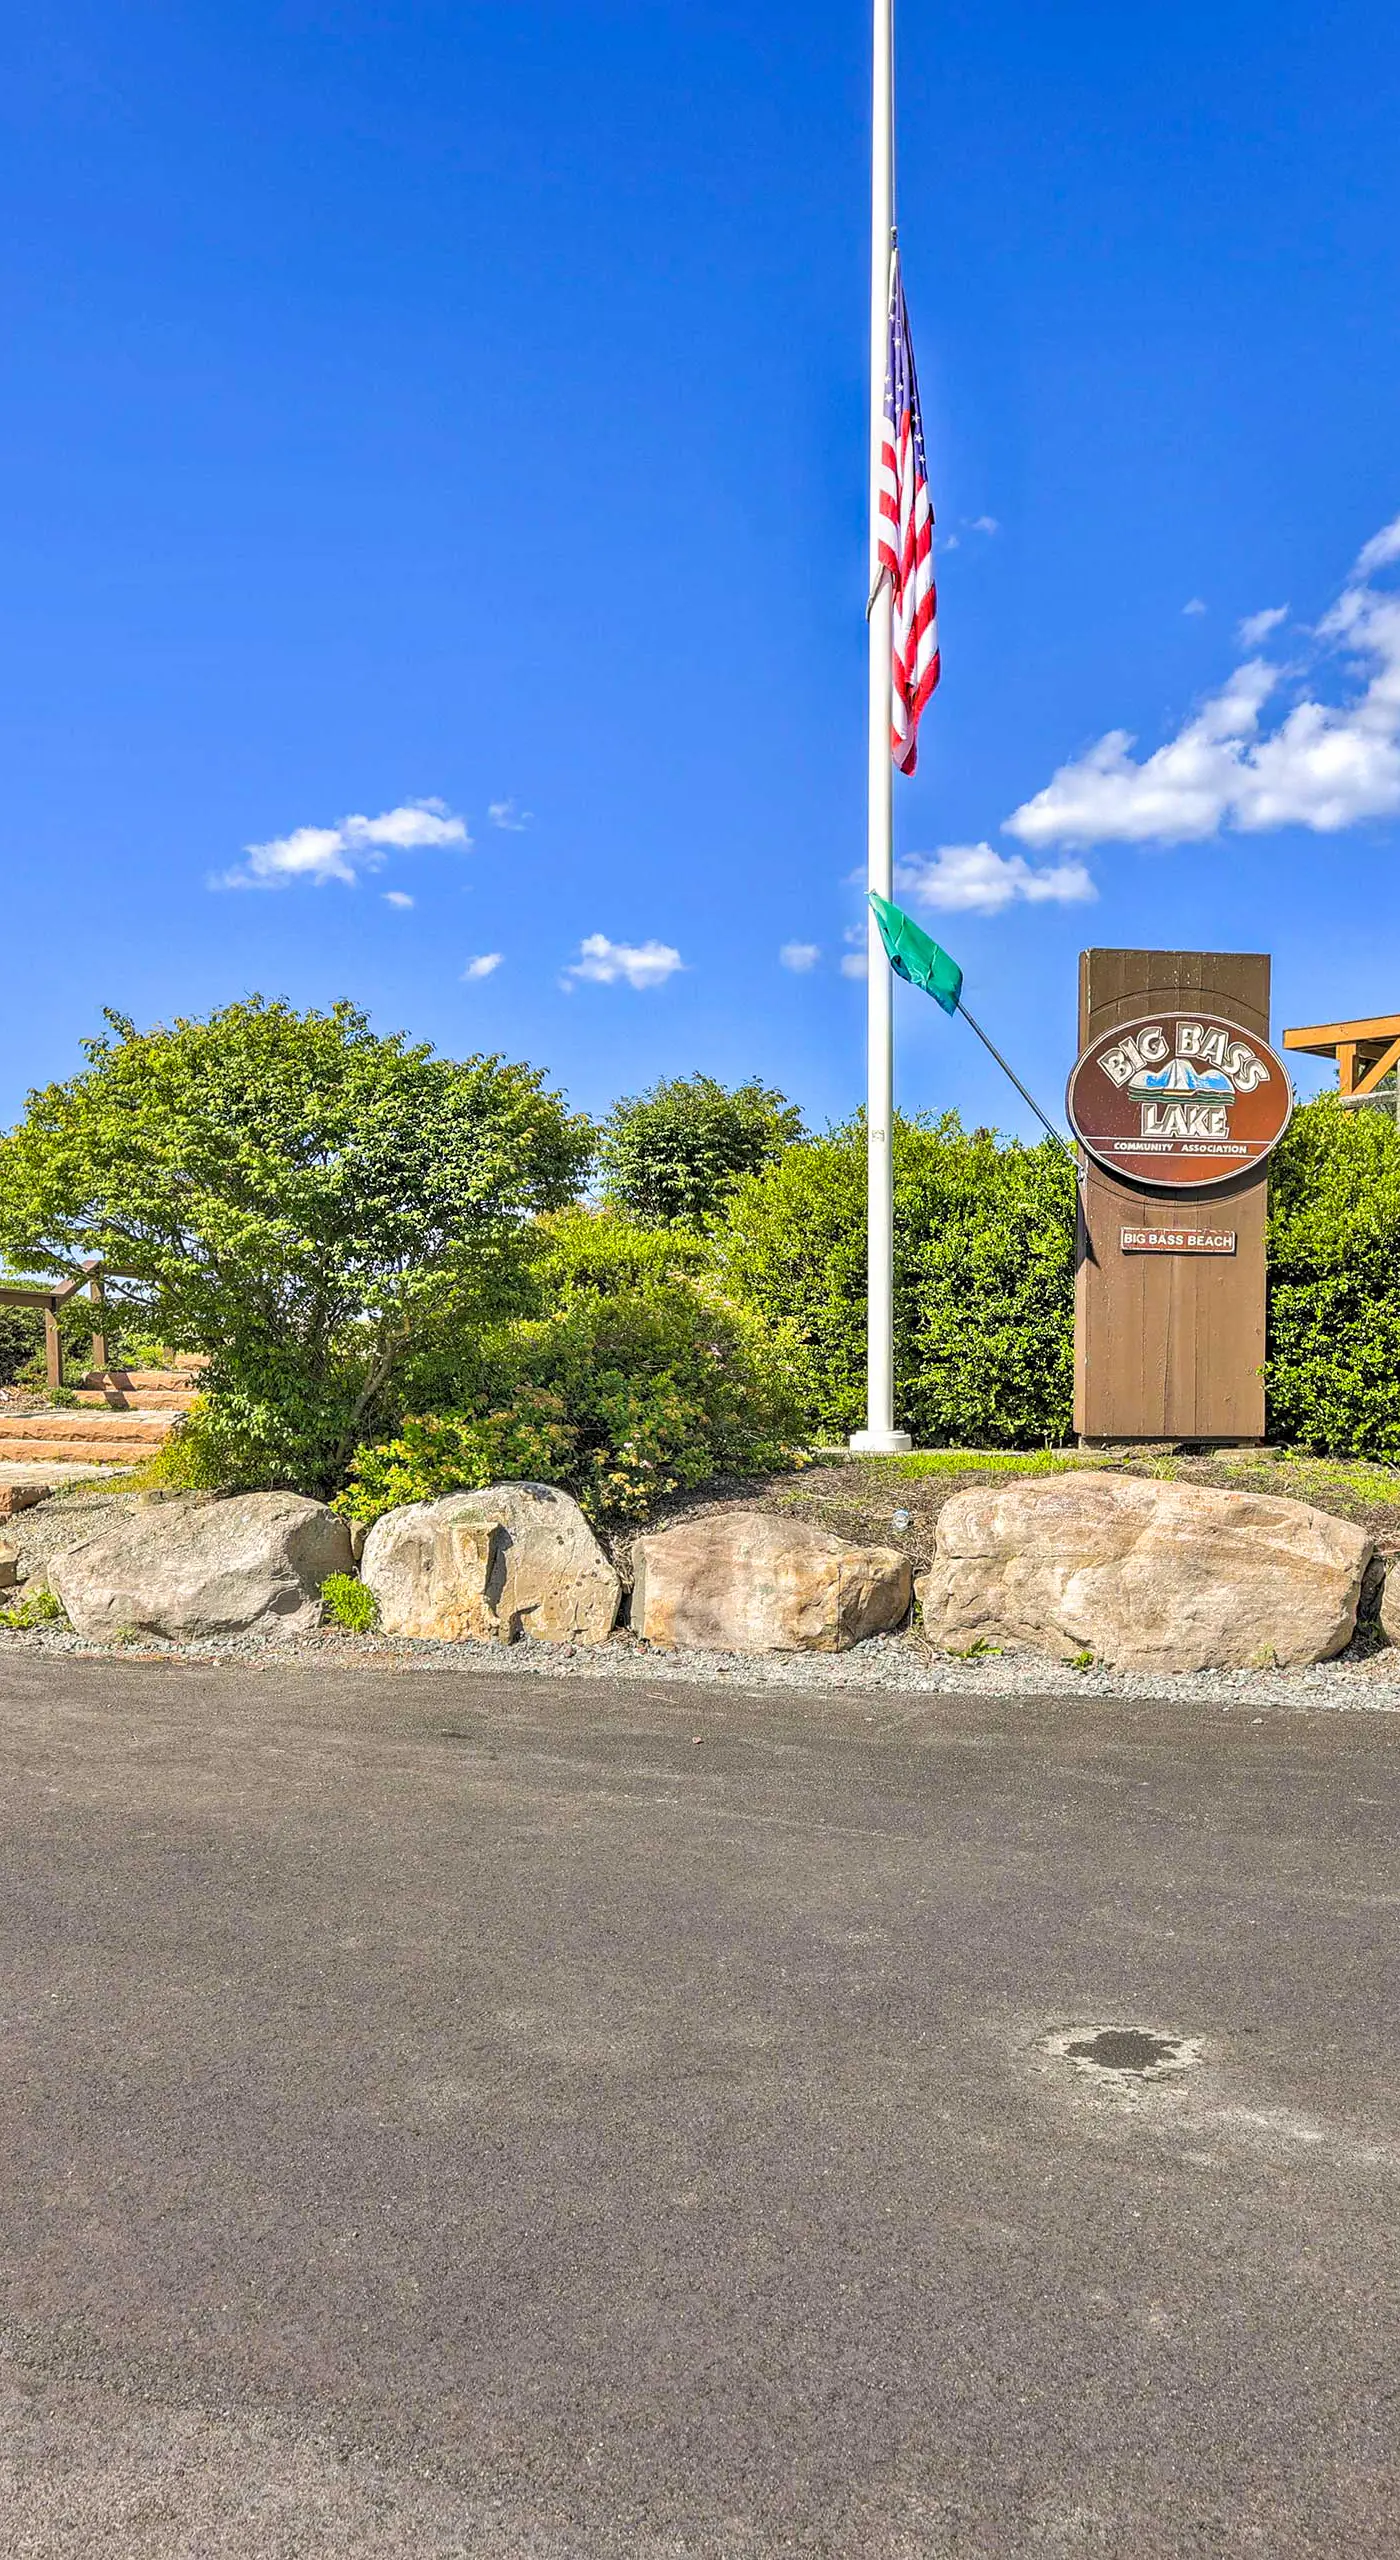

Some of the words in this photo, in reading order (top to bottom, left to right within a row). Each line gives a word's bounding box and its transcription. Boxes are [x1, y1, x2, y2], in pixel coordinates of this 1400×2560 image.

[1097, 1026, 1169, 1088] BIG
[1175, 1021, 1271, 1093] BASS
[1141, 1103, 1229, 1139] LAKE
[1113, 1141, 1174, 1151] COMMUNITY
[1181, 1143, 1247, 1154] ASSOCIATION
[1123, 1233, 1146, 1244] BIG
[1148, 1234, 1184, 1245] BASS
[1187, 1235, 1232, 1247] BEACH
